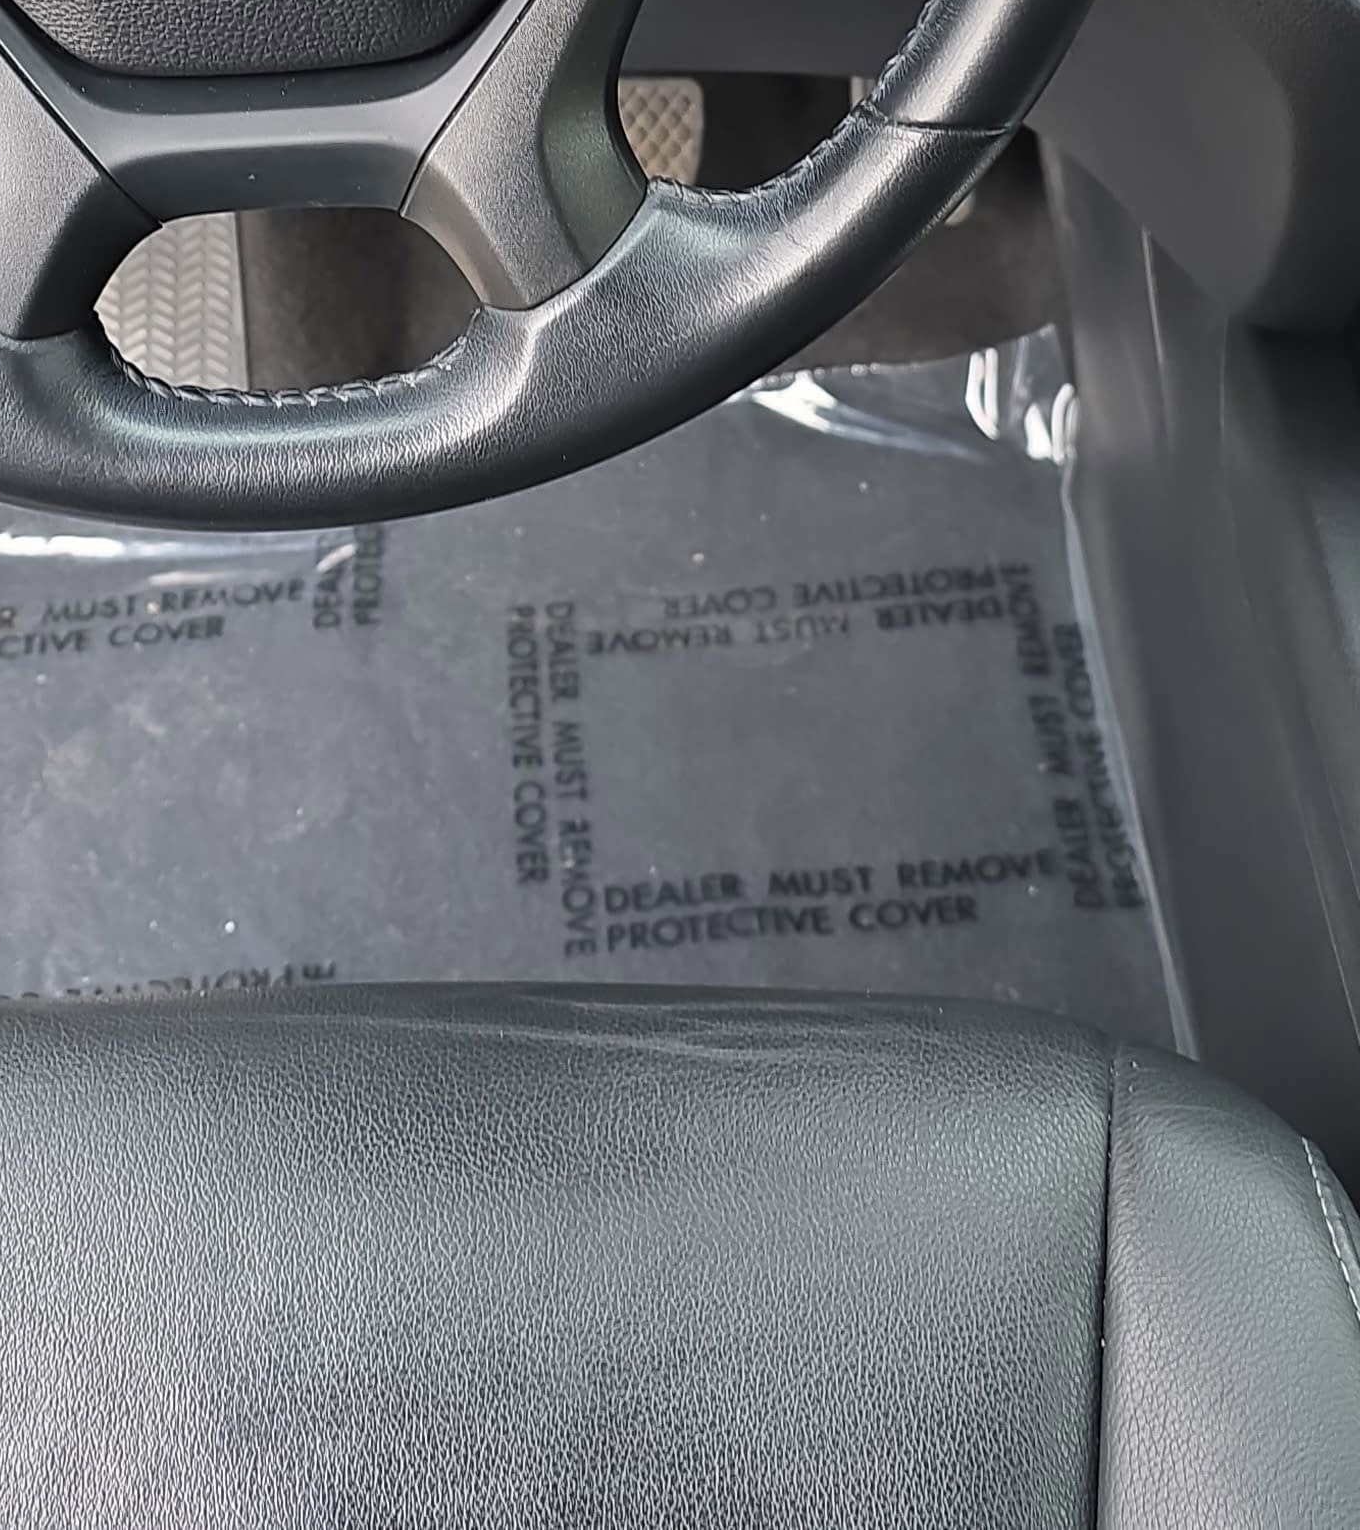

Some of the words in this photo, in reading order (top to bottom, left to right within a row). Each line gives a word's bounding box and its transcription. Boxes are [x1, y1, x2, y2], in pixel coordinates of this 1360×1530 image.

[42, 594, 138, 624] MUST
[160, 577, 306, 612] REMOVE
[662, 587, 779, 619] COVER
[876, 594, 1003, 632] DEALER
[109, 615, 225, 649] COVER
[544, 600, 580, 703] DEALER
[585, 620, 736, 655] REMOVE
[505, 604, 545, 770] PROTECTIVE
[551, 720, 590, 803] MUST
[513, 779, 551, 886] COVER
[557, 816, 598, 958] REMOVE
[604, 874, 743, 915] DEALER
[768, 866, 874, 898] MUST
[898, 847, 1057, 891] REMOVE
[605, 908, 835, 953] PROTECTIVE
[849, 896, 979, 934] COVER
